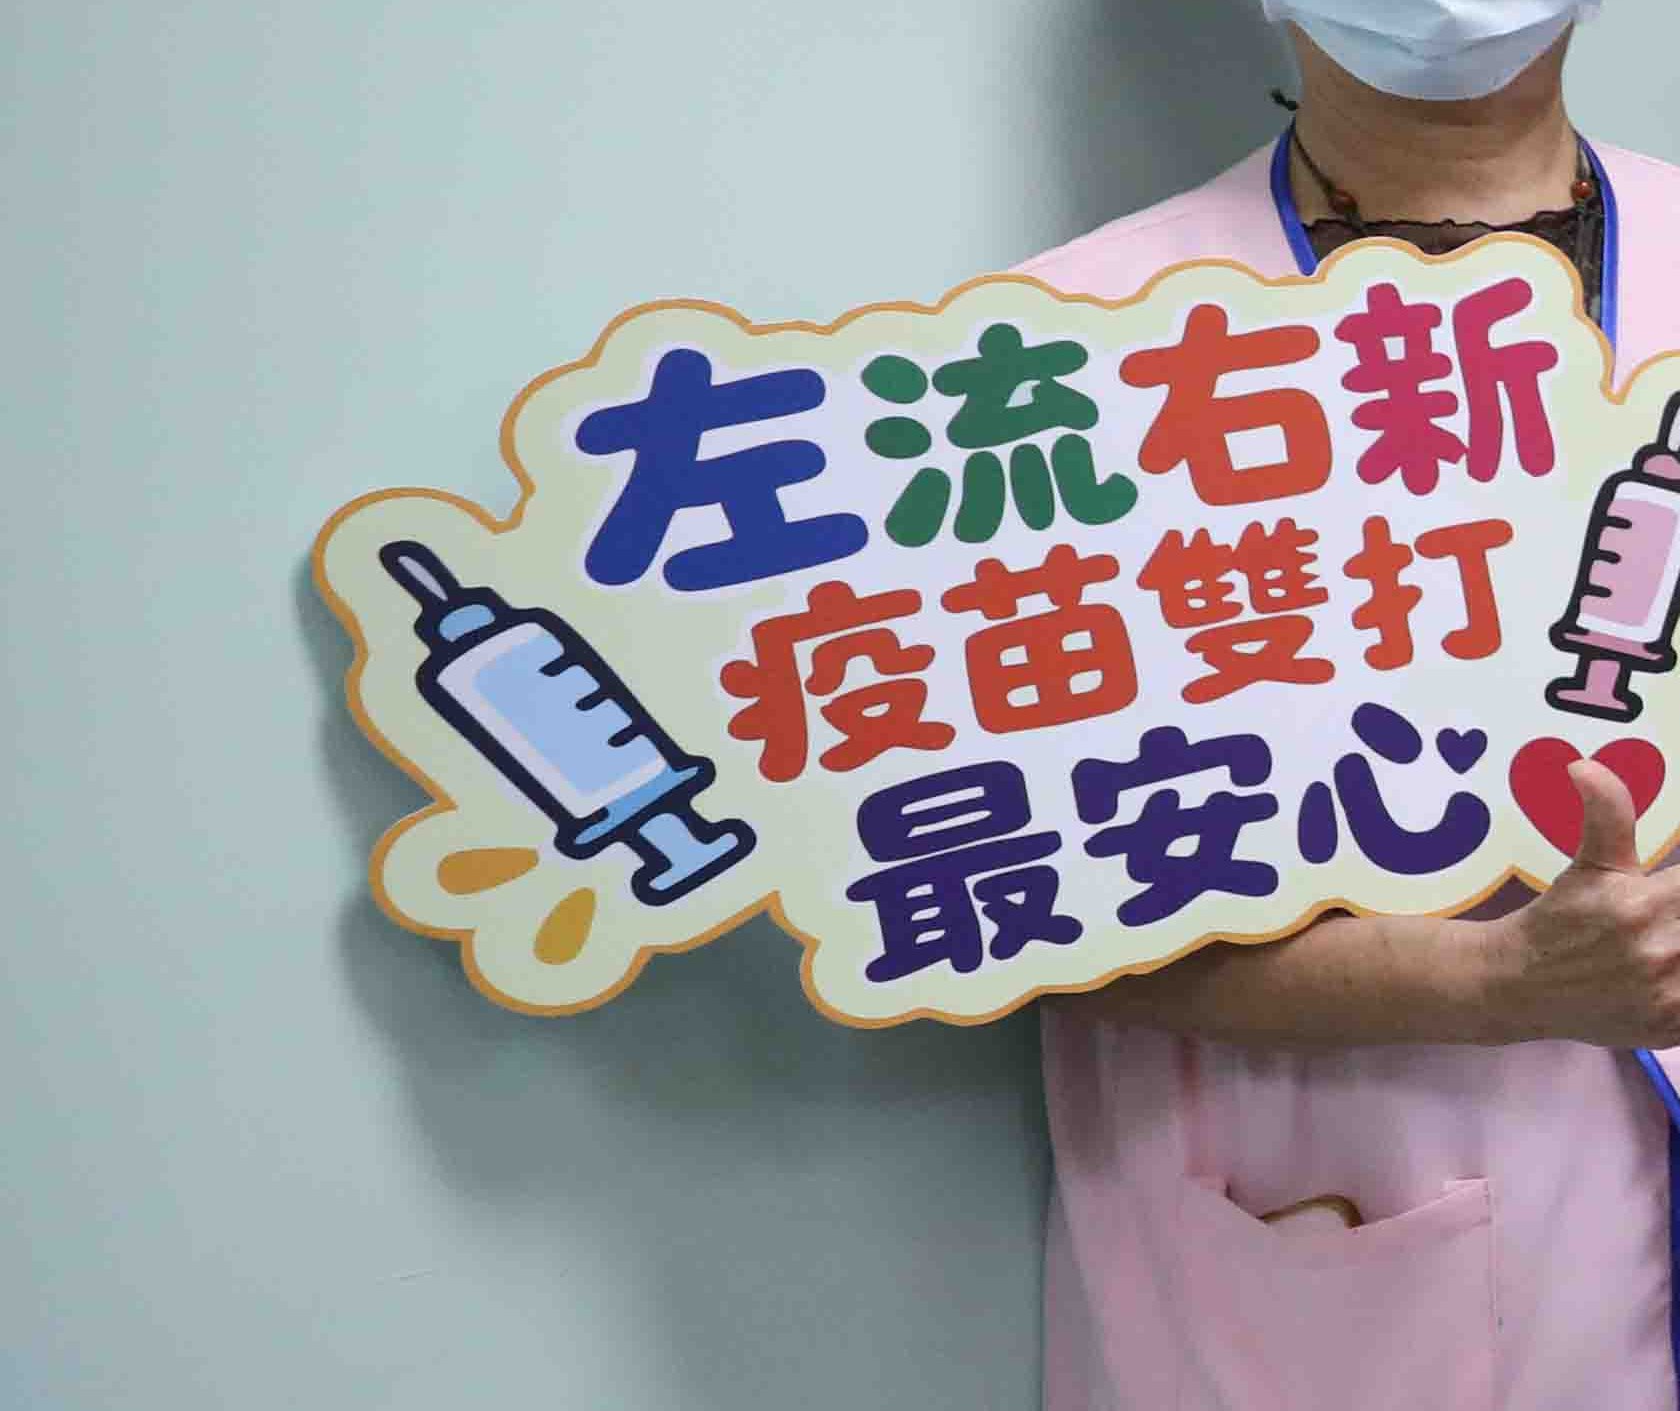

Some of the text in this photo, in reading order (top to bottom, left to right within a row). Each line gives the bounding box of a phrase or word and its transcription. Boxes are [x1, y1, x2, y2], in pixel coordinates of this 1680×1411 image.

[574, 276, 1558, 591] 左流右新
[720, 516, 1514, 783] 疫苗雙打
[848, 700, 1491, 983] 最安心
